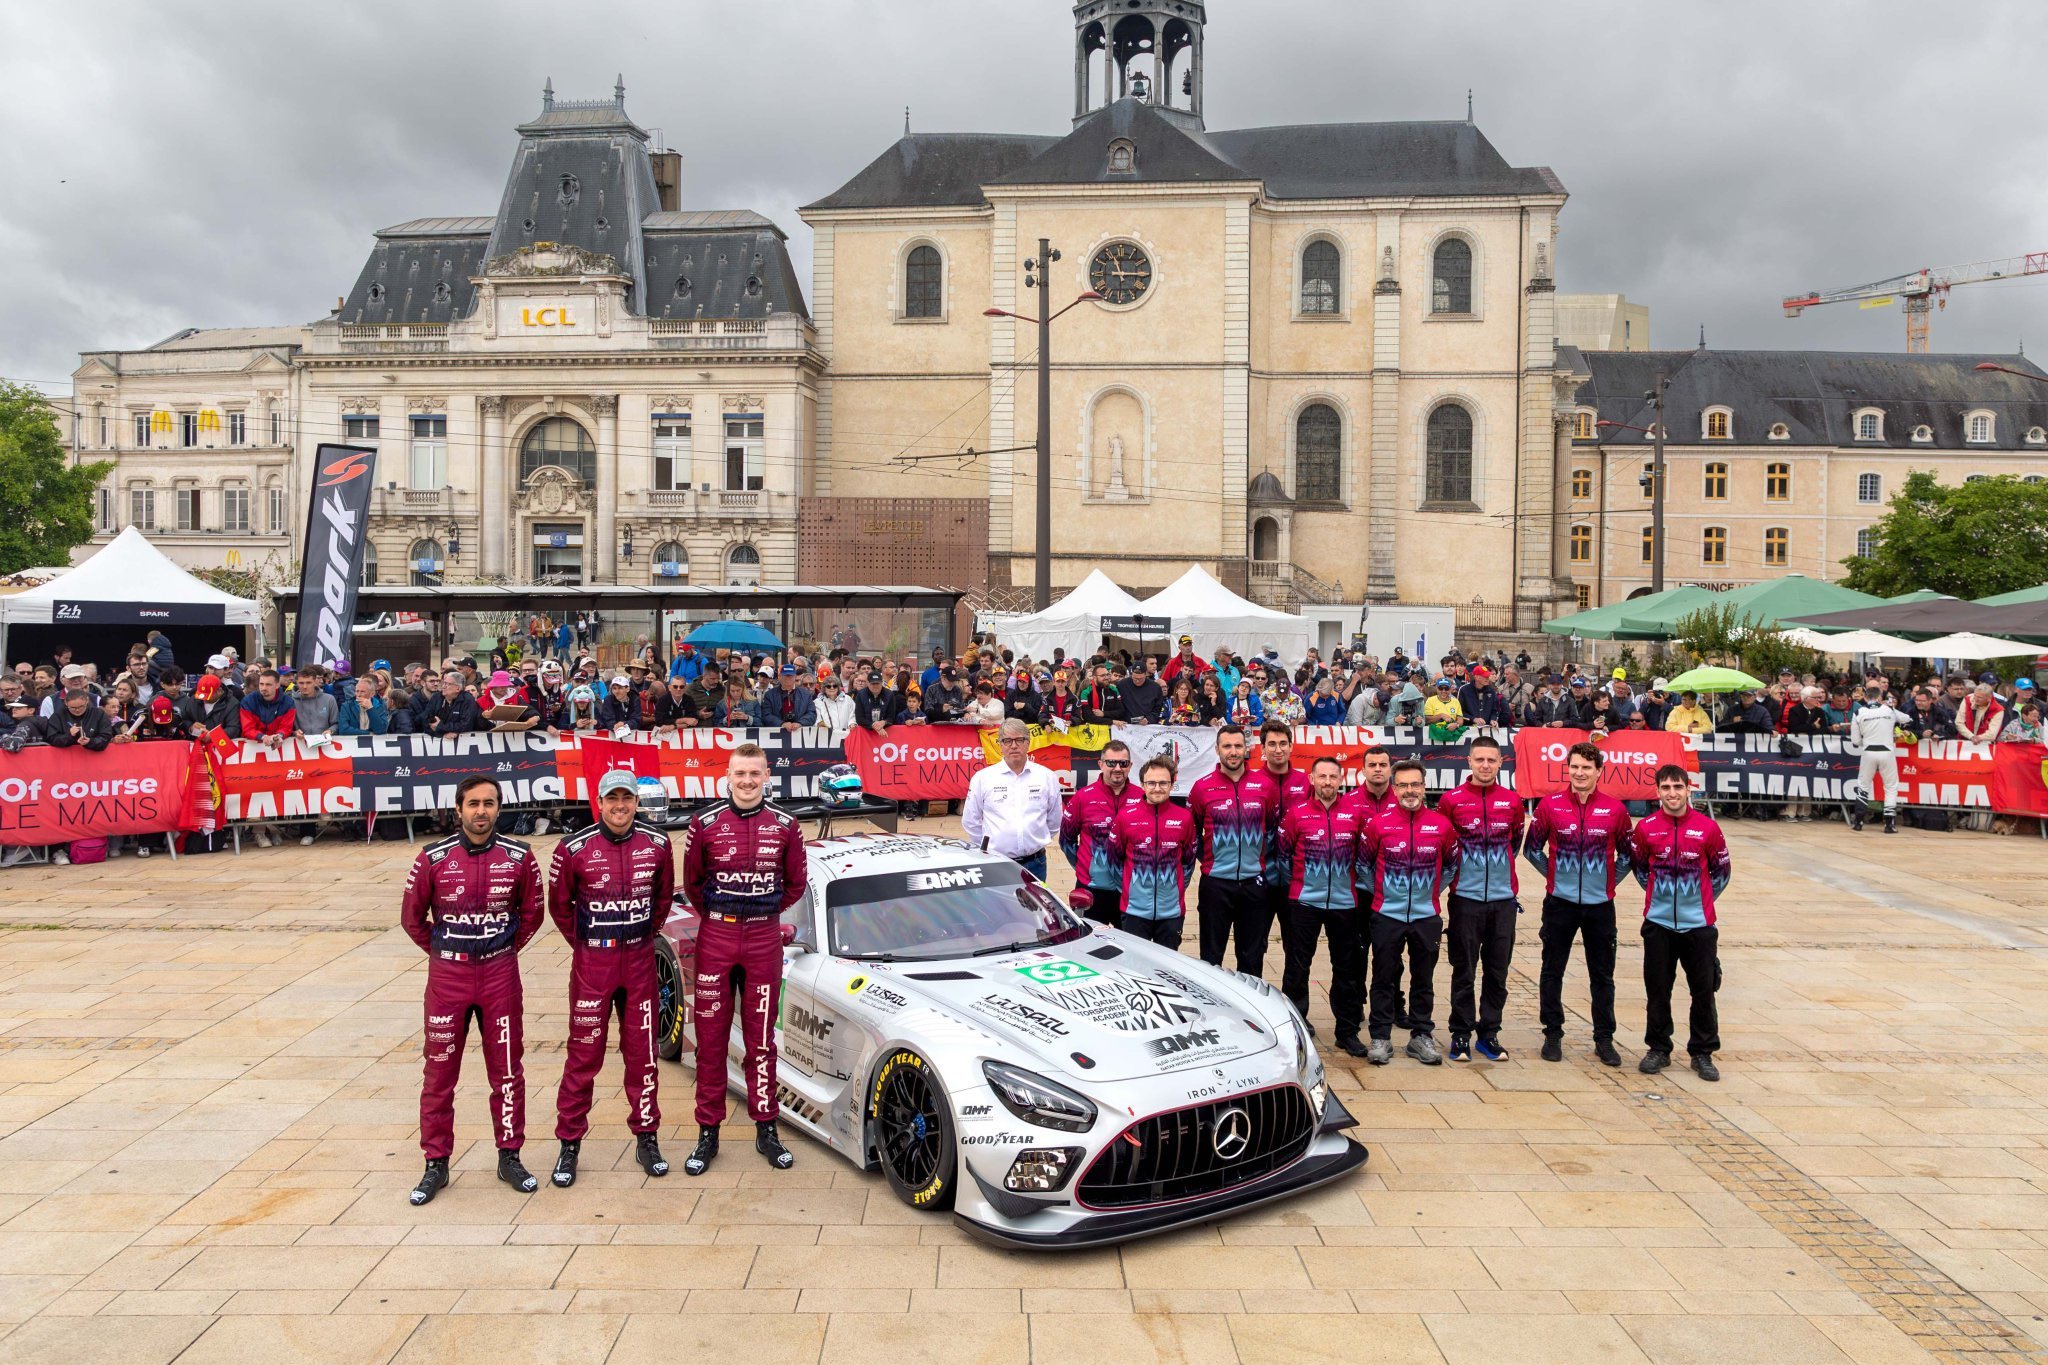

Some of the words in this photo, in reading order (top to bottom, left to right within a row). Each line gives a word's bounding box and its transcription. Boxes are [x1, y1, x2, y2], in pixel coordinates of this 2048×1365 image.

[522, 308, 576, 326] LCL
[913, 744, 984, 762] course
[1541, 743, 1567, 762] :O
[880, 765, 908, 786] LE
[50, 776, 158, 800] course
[58, 796, 158, 827] MANS
[820, 840, 933, 862] MOTORSPORTS
[870, 845, 940, 857] ACADEMY
[716, 872, 774, 883] QATAR
[907, 868, 984, 890] QMMF
[589, 896, 650, 912] QATAR
[442, 912, 510, 926] QATAR
[1030, 962, 1096, 981] 62
[1093, 998, 1120, 1008] QATAR
[670, 1004, 684, 1044] EAGLE
[786, 1002, 834, 1040] QMMF
[976, 1001, 1029, 1027] INTERNATIONAL
[1030, 1024, 1060, 1040] CIRCUIT
[1092, 1010, 1130, 1022] ACADEMY
[1144, 1028, 1221, 1058] QMMF
[784, 1046, 814, 1068] QATAR
[1187, 1086, 1217, 1100] IRON
[1236, 1076, 1261, 1088] LYNX
[957, 1105, 994, 1116] QMMF
[961, 1132, 1034, 1146] GOODYEAR
